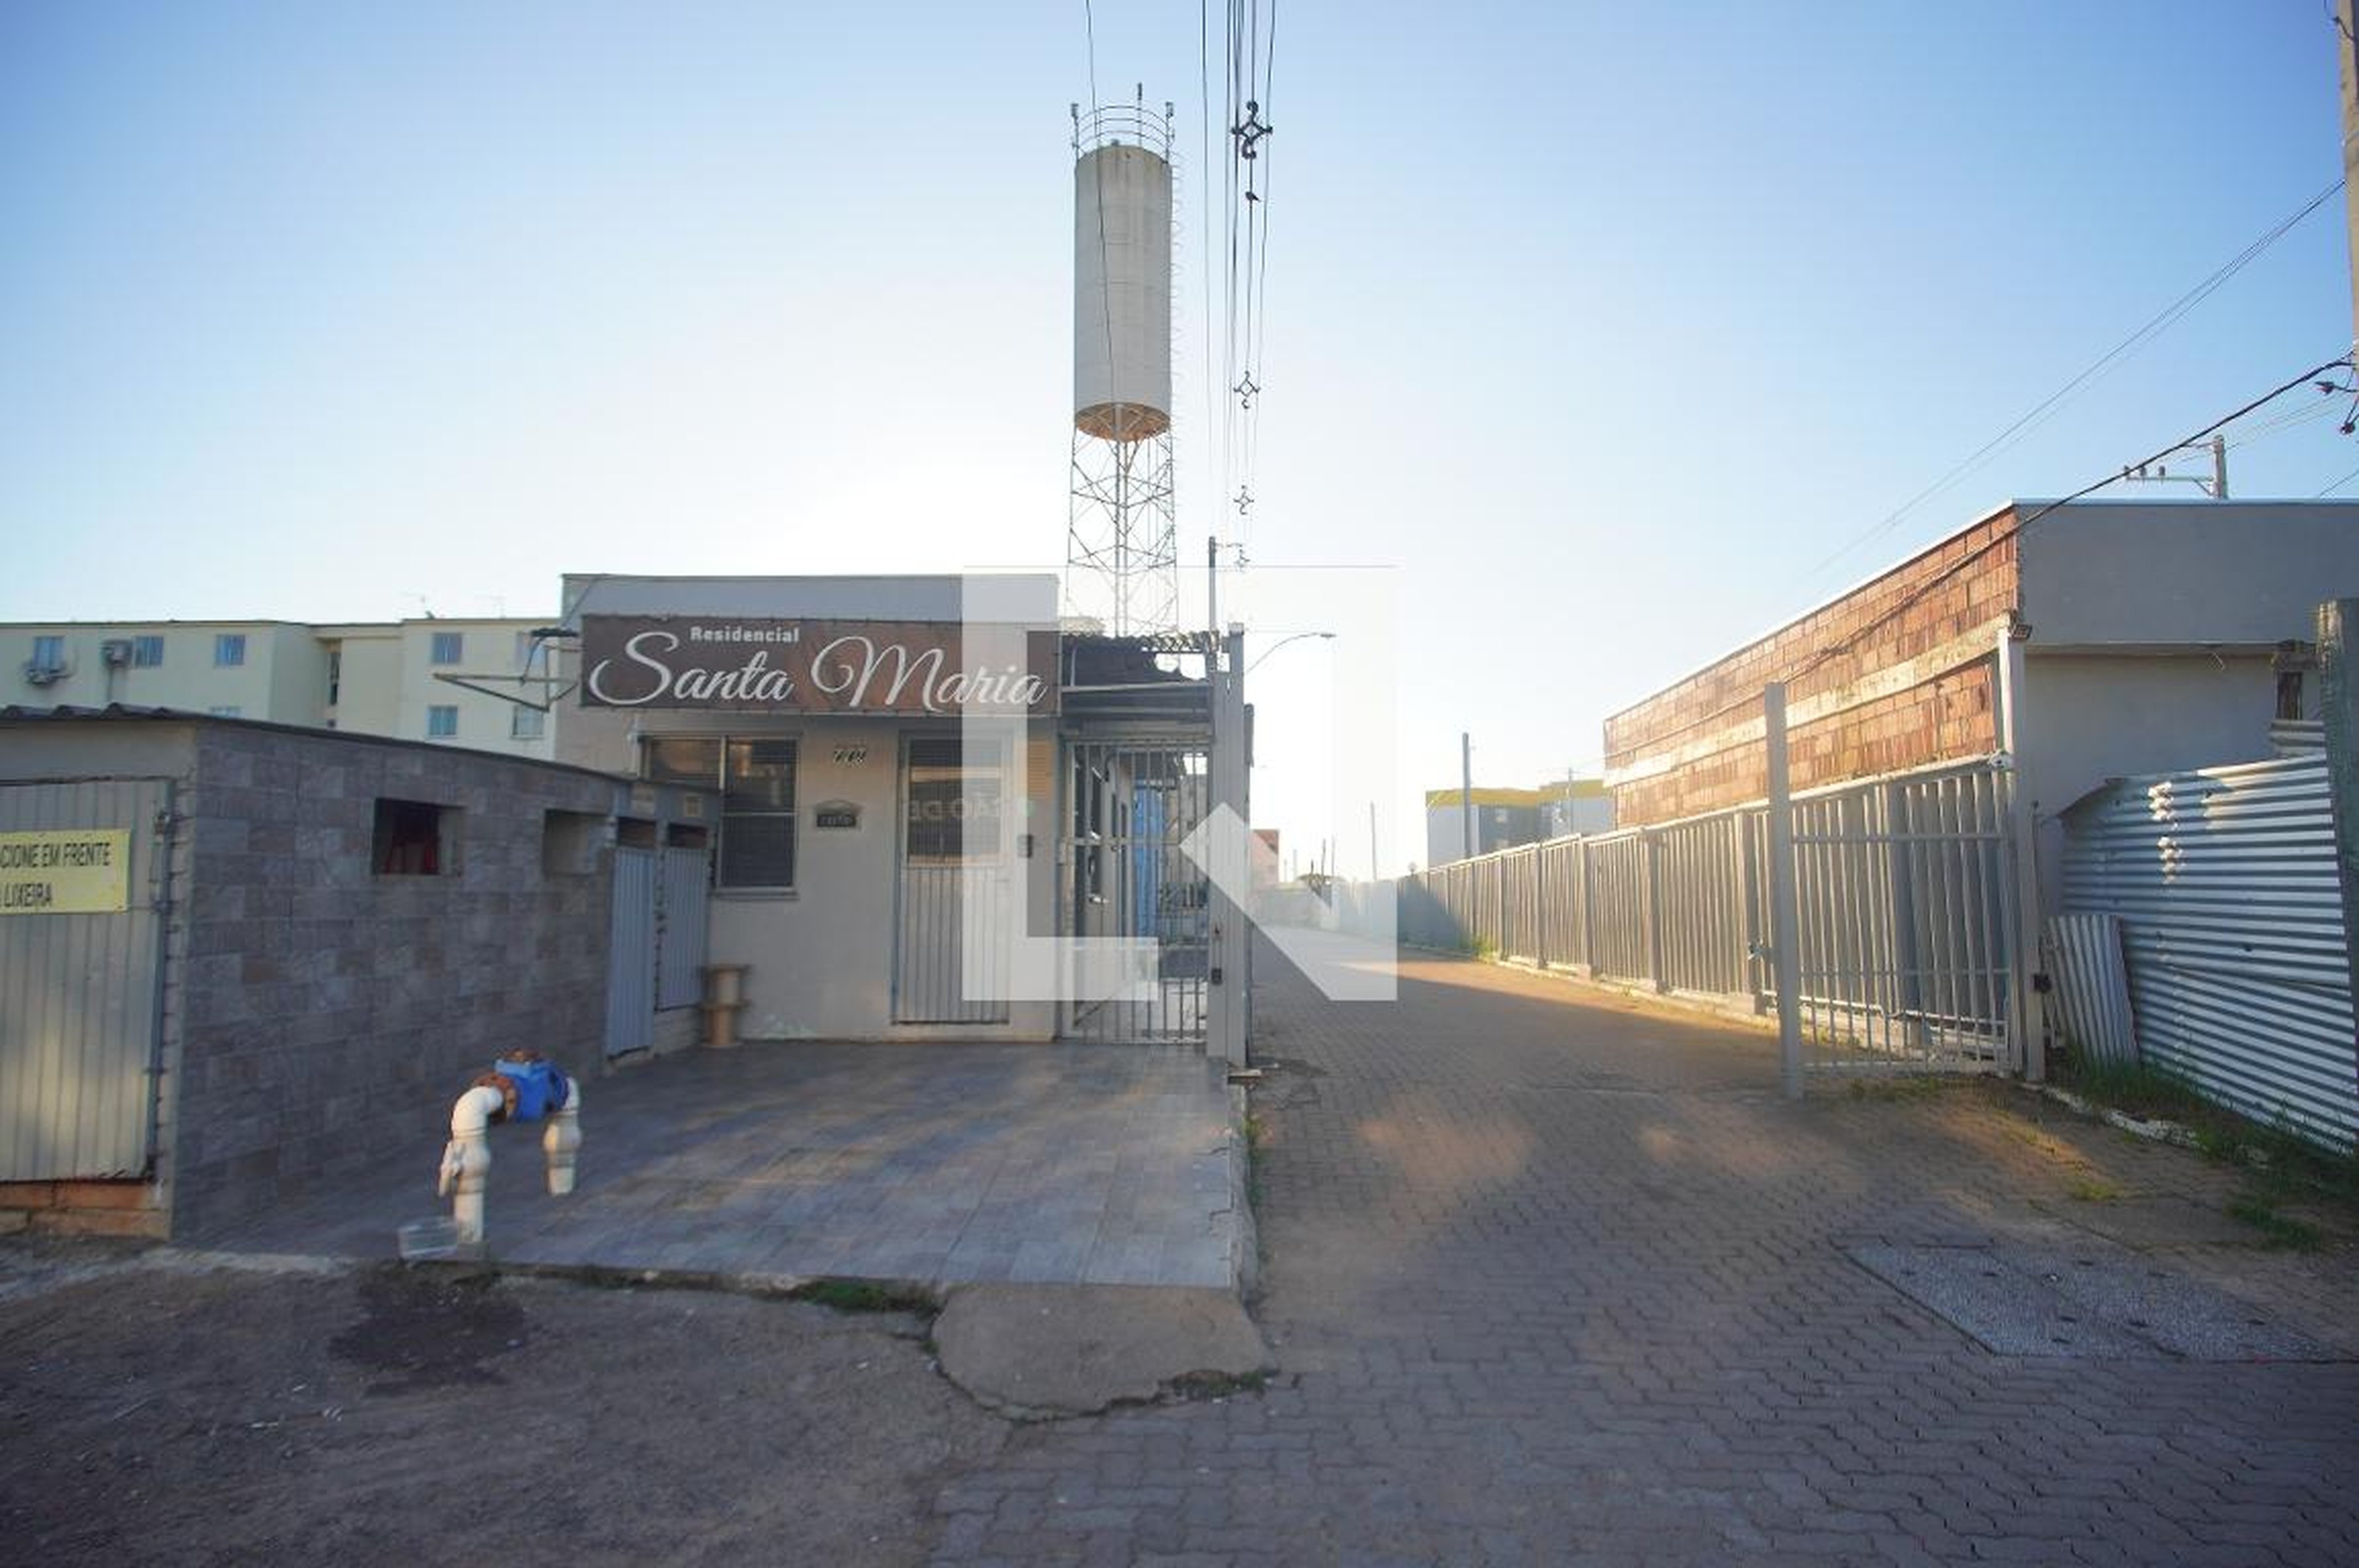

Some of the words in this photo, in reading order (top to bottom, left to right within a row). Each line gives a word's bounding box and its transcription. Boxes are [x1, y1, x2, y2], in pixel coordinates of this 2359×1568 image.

[690, 625, 800, 644] Residencial
[590, 631, 794, 705] Santa
[810, 635, 1047, 713] Maria
[0, 844, 39, 868] CIONE
[42, 843, 60, 867] EM
[64, 842, 111, 867] FRENTE
[4, 881, 52, 907] LIXEIRA
